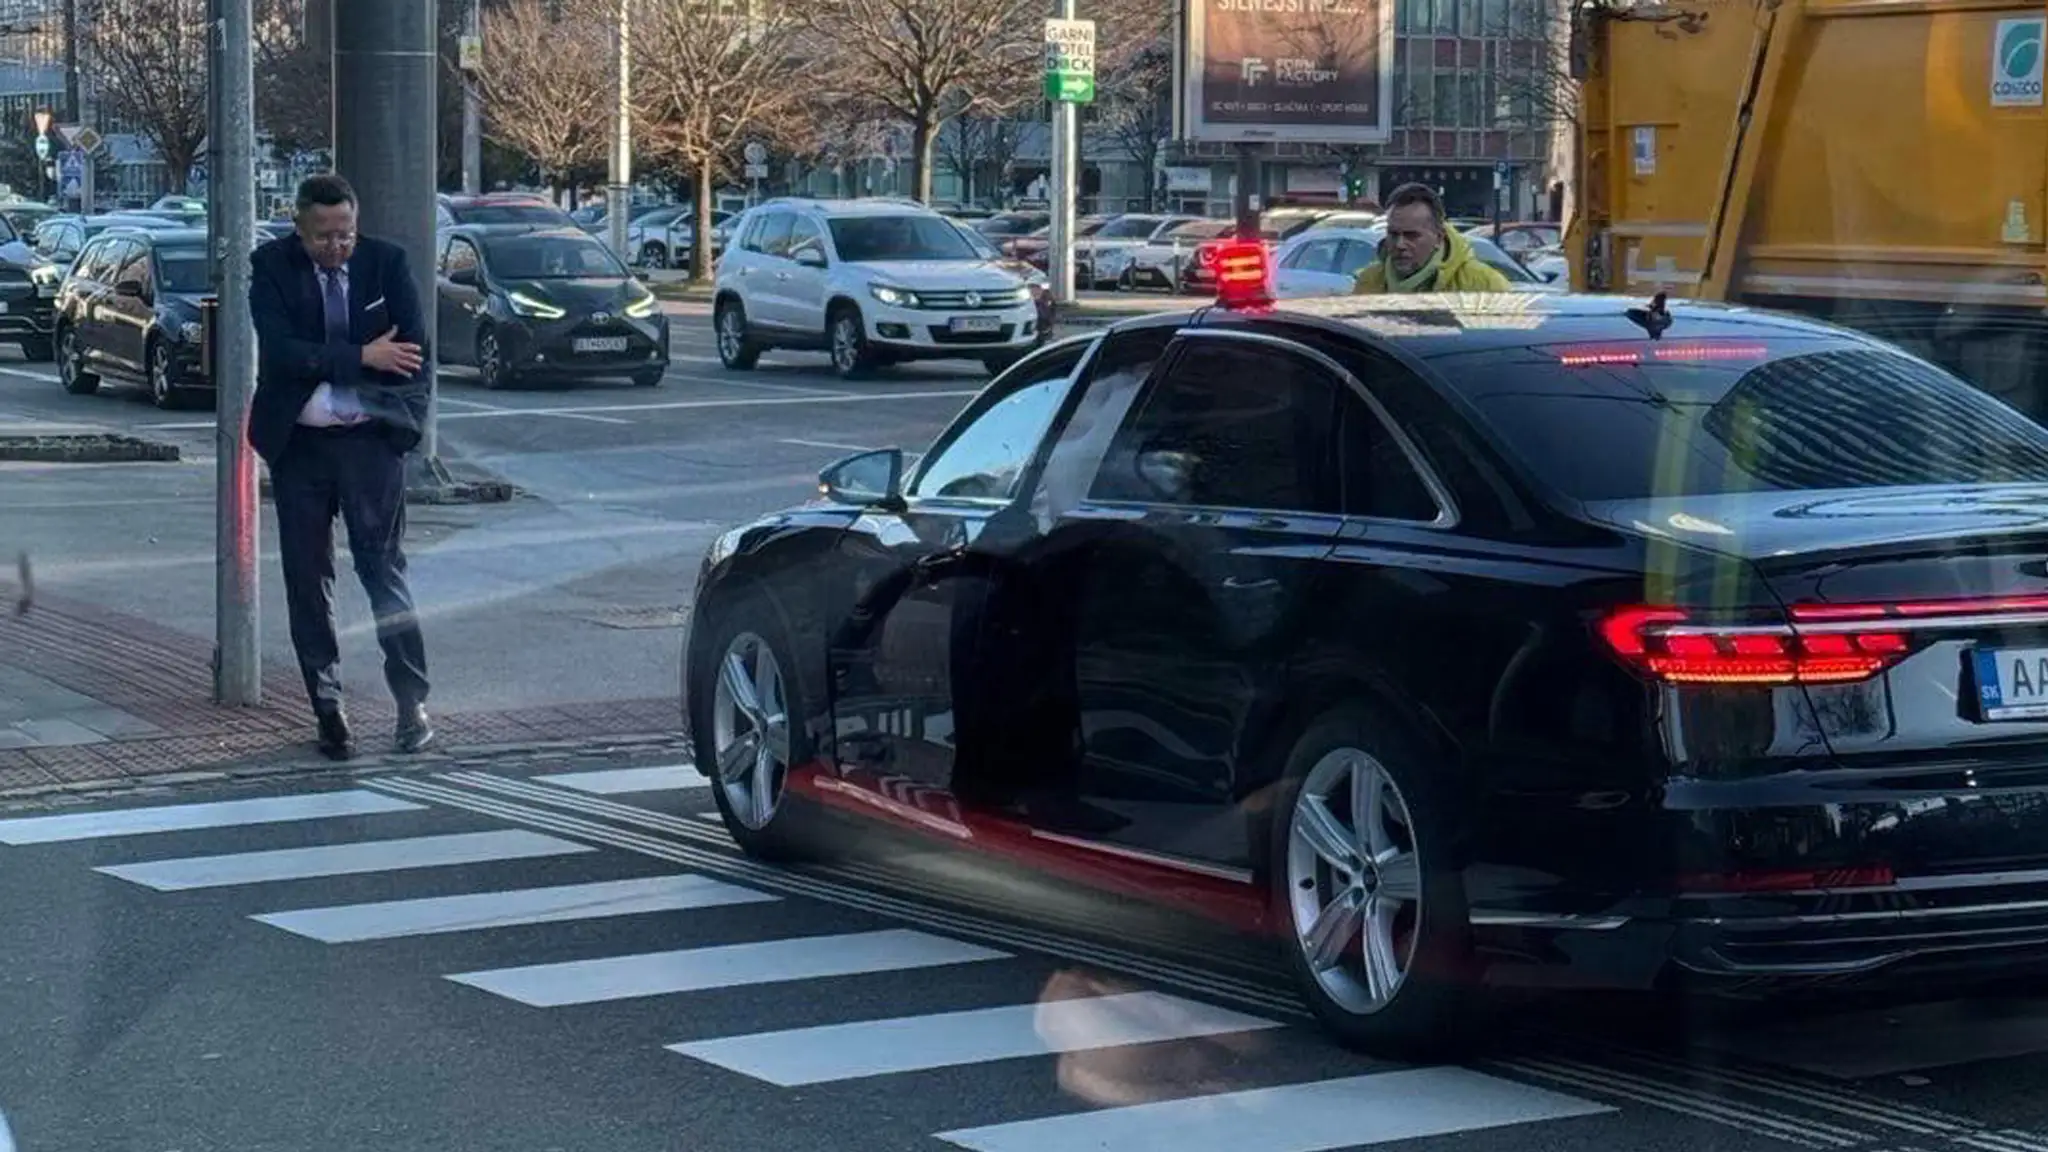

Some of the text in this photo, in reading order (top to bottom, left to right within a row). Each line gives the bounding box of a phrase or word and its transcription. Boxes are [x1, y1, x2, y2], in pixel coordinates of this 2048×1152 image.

[1046, 43, 1092, 56] HOTEL
[1276, 69, 1339, 83] FACTORY
[1981, 685, 1999, 699] SK
